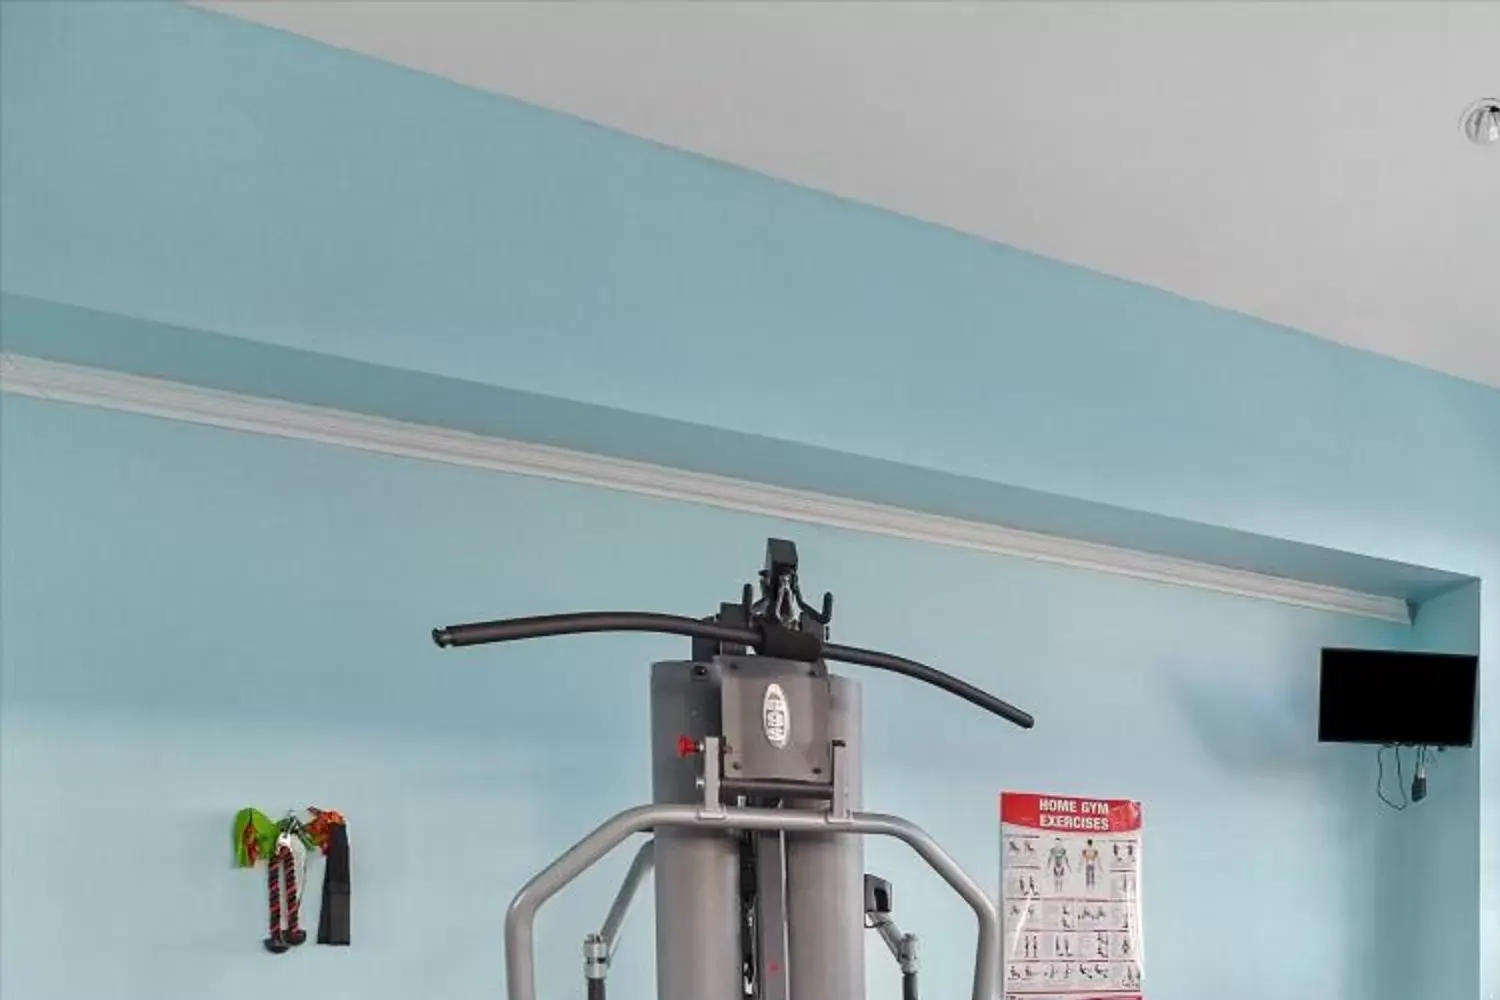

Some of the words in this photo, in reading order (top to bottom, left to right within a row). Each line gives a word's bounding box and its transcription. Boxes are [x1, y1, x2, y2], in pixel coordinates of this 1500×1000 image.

[1040, 798, 1077, 813] HOME
[1081, 801, 1108, 815] GYM
[1040, 814, 1108, 830] EXERCISES
